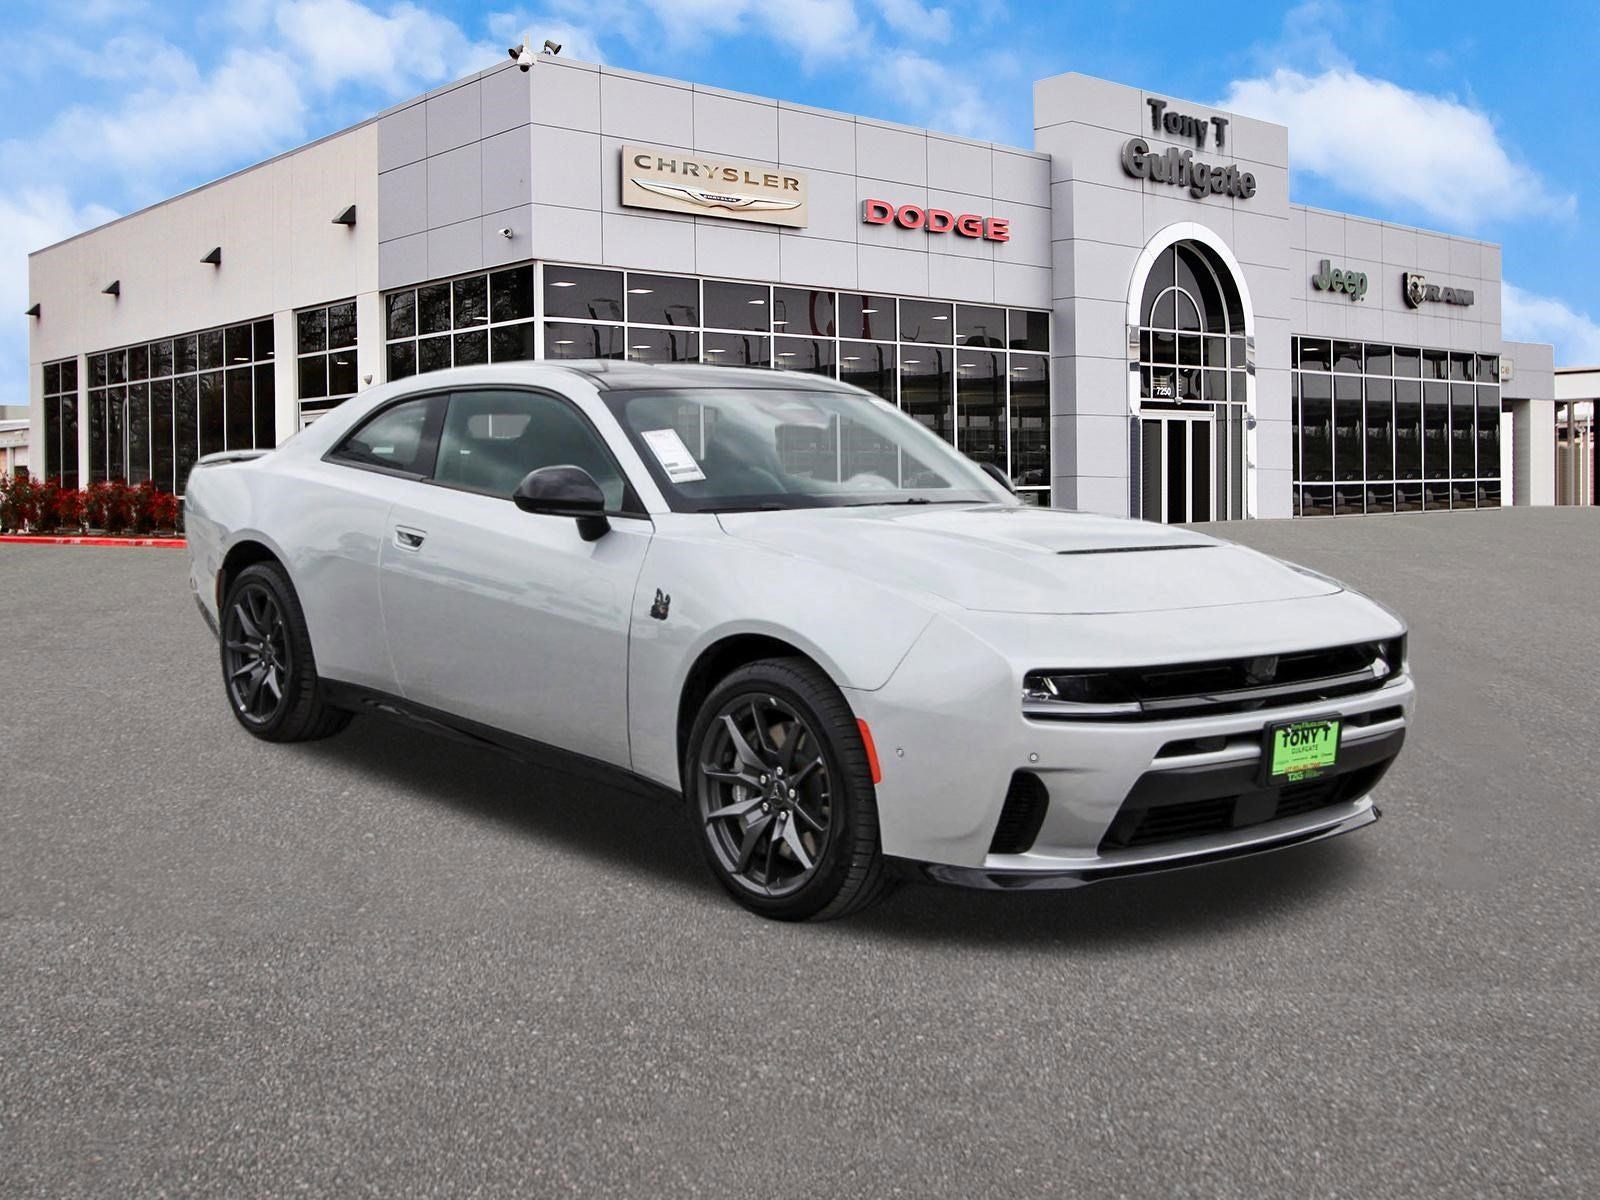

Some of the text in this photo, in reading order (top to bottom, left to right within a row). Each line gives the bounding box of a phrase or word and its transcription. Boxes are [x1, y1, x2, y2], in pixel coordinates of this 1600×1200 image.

[1146, 98, 1229, 148] Tony T
[633, 154, 801, 192] CHRYSLER
[1121, 138, 1257, 199] Gulfgate
[862, 199, 1010, 242] DODGE
[1312, 259, 1368, 302] Jeep
[1424, 284, 1475, 307] RAM
[1156, 387, 1171, 396] 7250
[1282, 726, 1331, 748] TONY T
